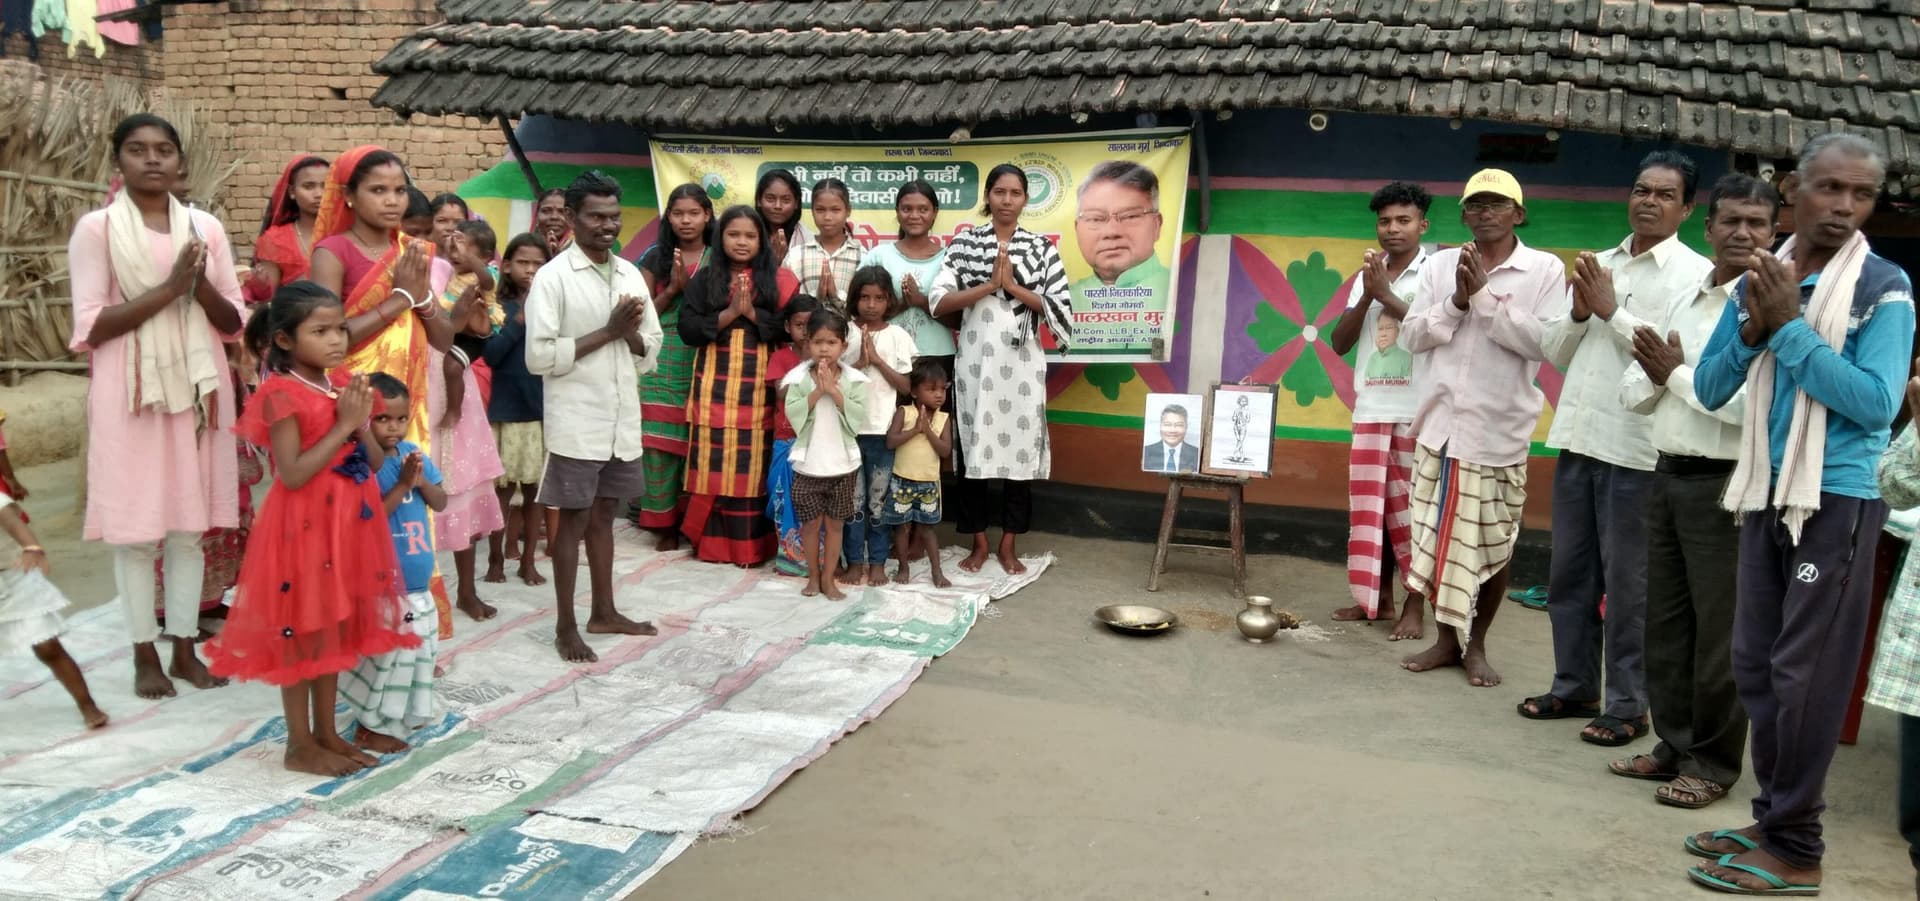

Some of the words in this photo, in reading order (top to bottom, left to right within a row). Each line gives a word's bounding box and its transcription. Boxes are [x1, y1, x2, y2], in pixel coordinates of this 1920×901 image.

[812, 166, 849, 183] नहीं
[851, 166, 871, 182] तो
[876, 166, 919, 183] कभी
[924, 165, 965, 184] नहीं,
[1084, 287, 1107, 298] पारसी
[1109, 286, 1153, 298] जितकारिया
